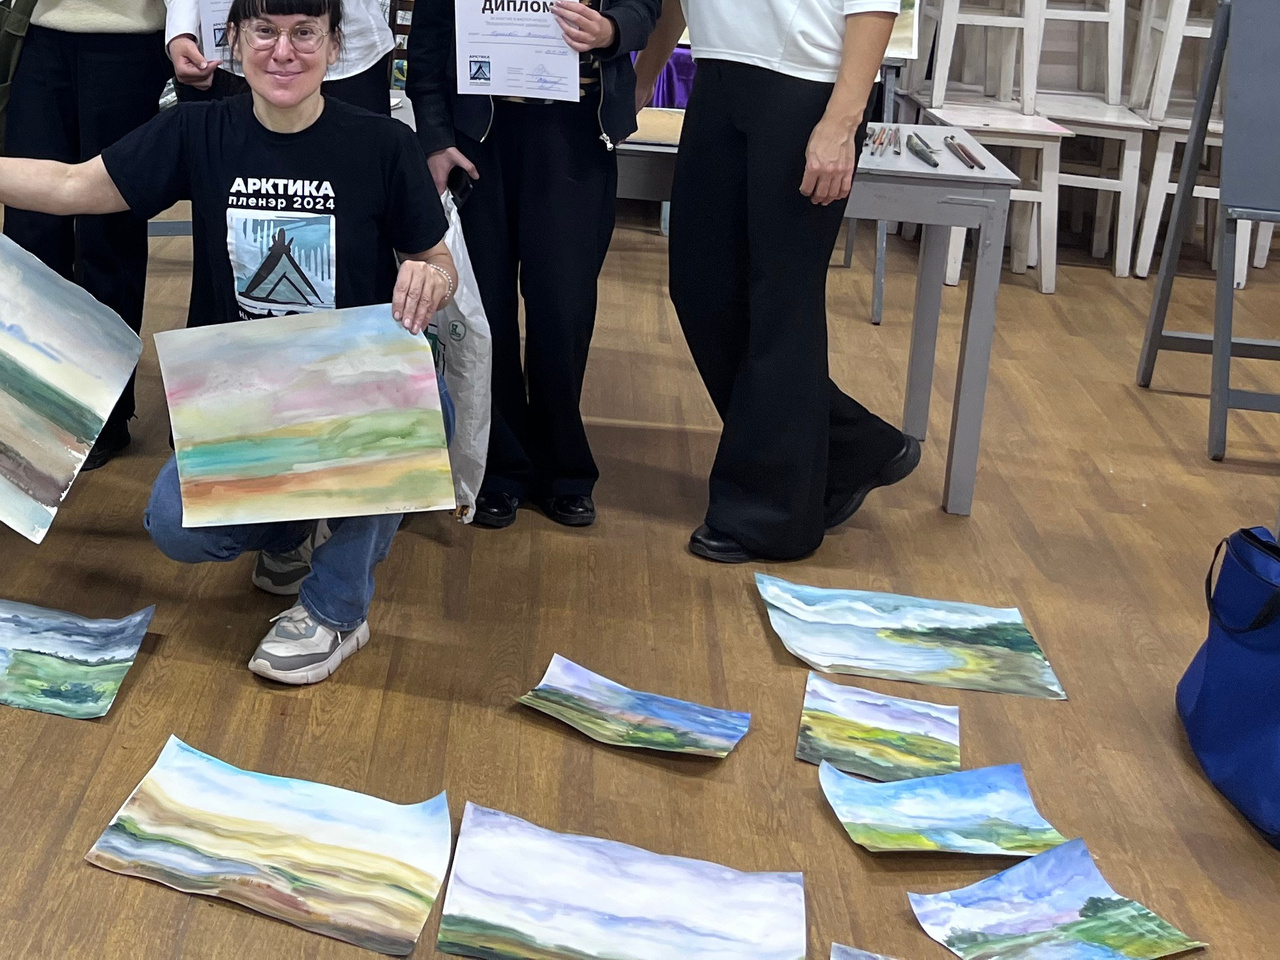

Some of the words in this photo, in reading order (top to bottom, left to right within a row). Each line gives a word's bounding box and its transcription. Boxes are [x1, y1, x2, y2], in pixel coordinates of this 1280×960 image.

[481, 0, 554, 14] ДИПЛОМ
[229, 177, 336, 198] АРКТИКА
[228, 195, 287, 210] пленэр
[293, 197, 336, 210] 2024
